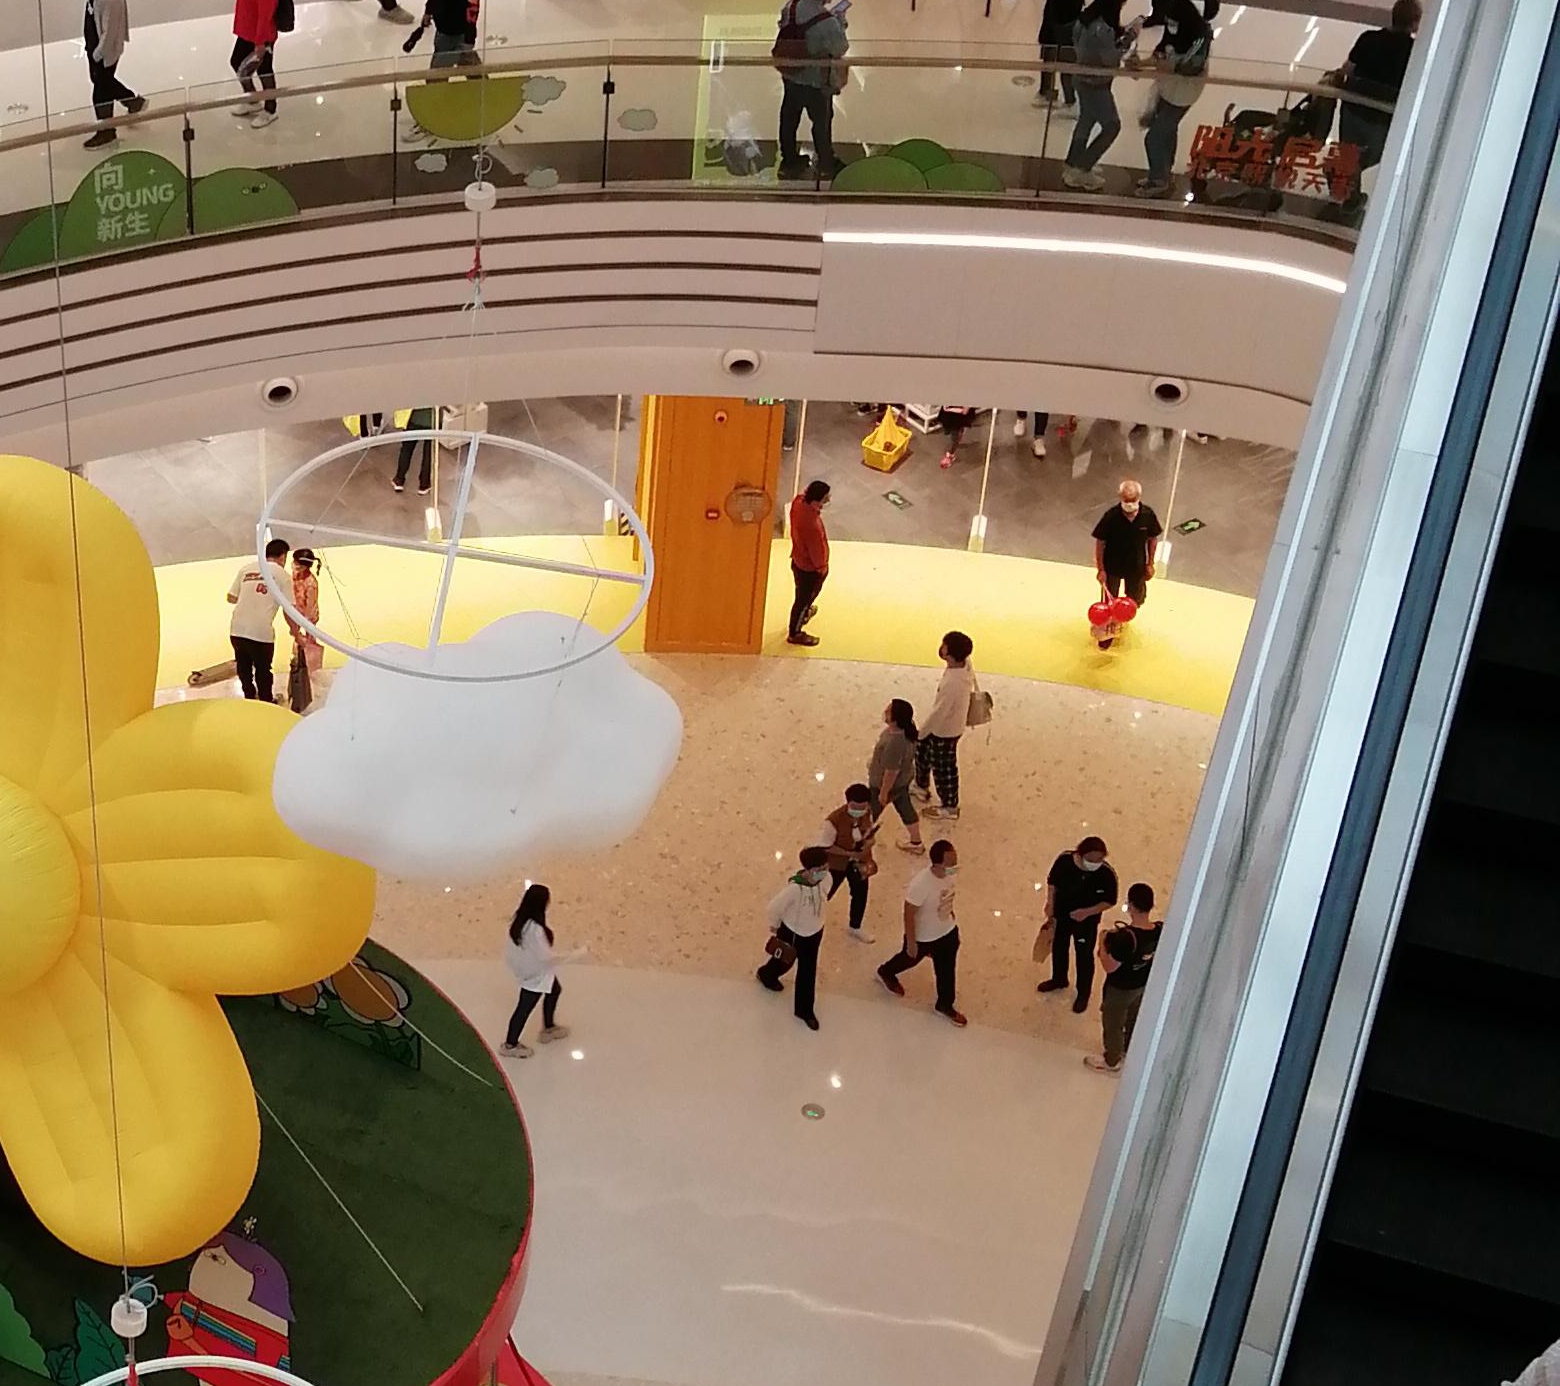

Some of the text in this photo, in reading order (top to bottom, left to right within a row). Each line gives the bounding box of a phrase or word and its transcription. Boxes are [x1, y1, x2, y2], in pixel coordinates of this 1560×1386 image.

[94, 161, 123, 194] 向
[96, 183, 176, 215] YOUNG
[97, 211, 151, 243] 新生
